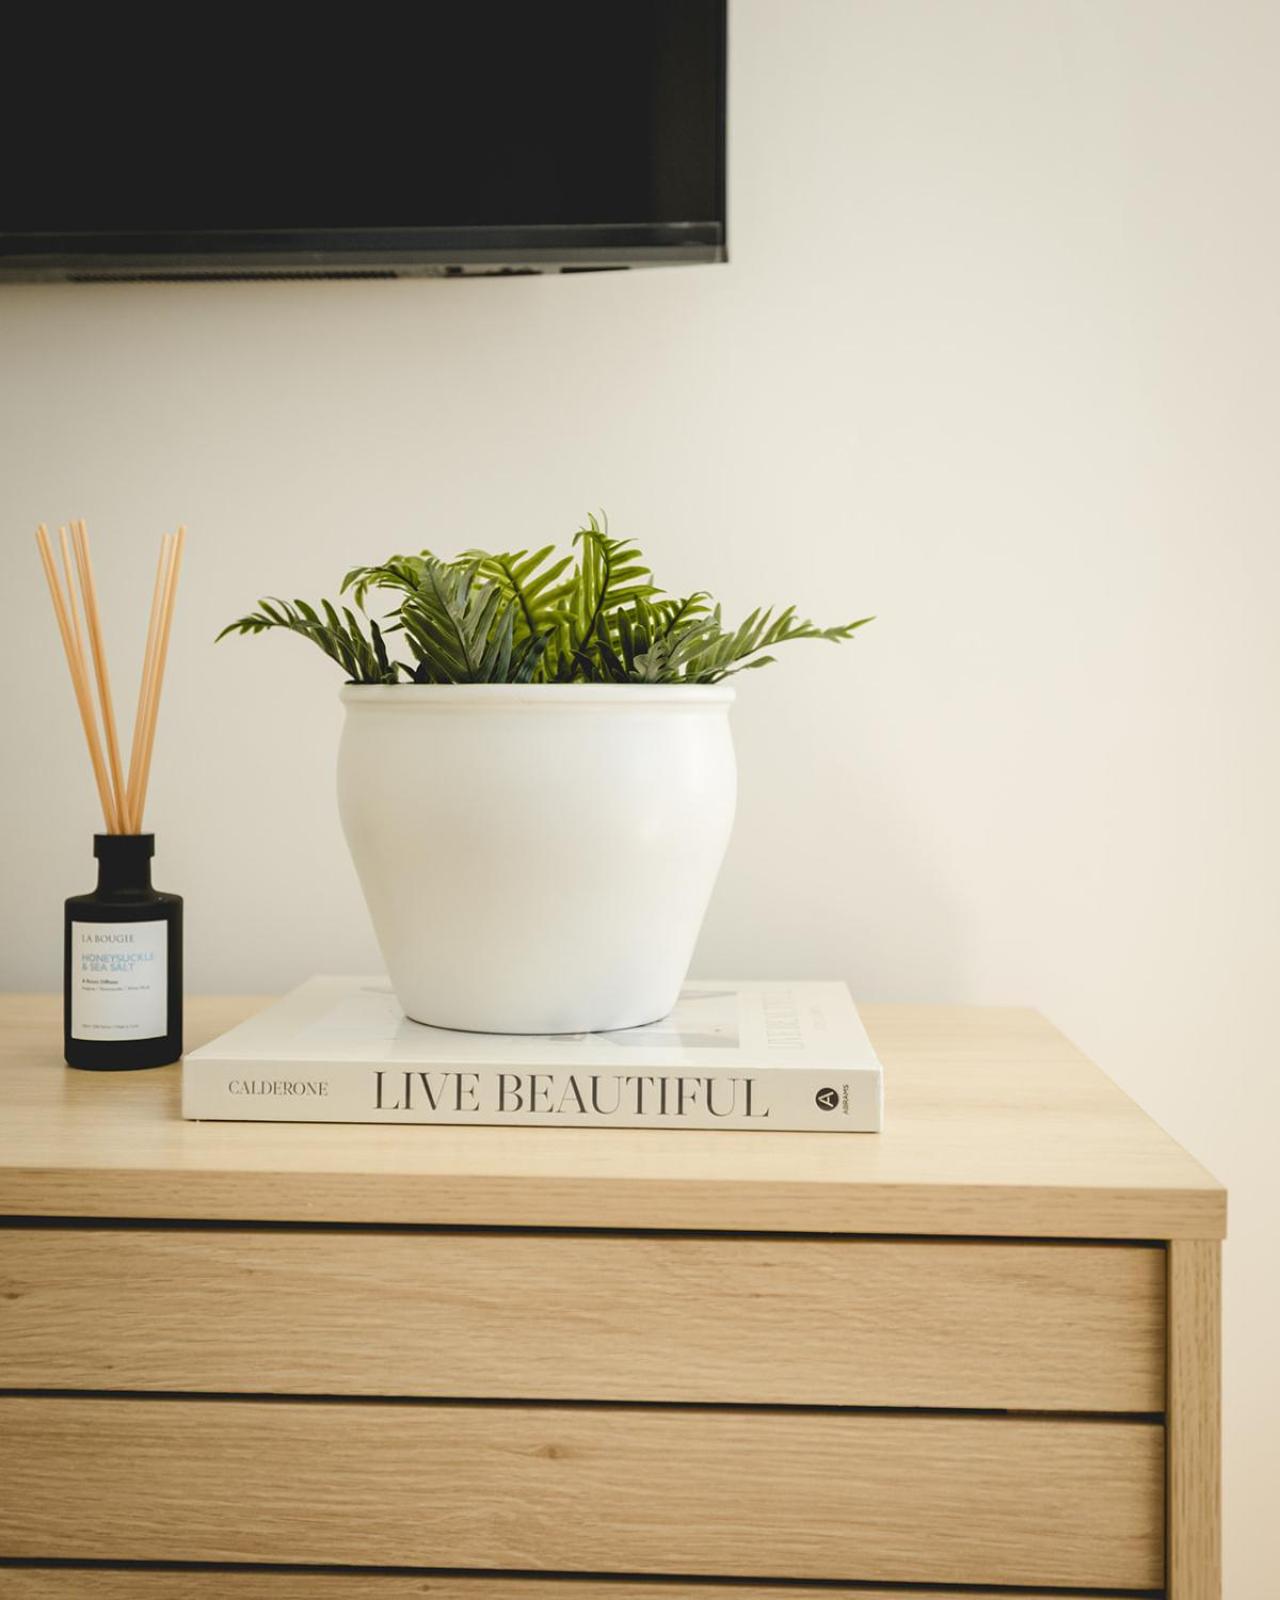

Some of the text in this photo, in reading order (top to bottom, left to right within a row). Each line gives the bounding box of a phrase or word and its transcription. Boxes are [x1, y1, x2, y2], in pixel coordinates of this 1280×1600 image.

[90, 963, 108, 972] SEA
[110, 963, 134, 972] SALT
[228, 1080, 329, 1097] CALDERONE
[372, 1071, 770, 1118] LIVE BEAUTIFUL
